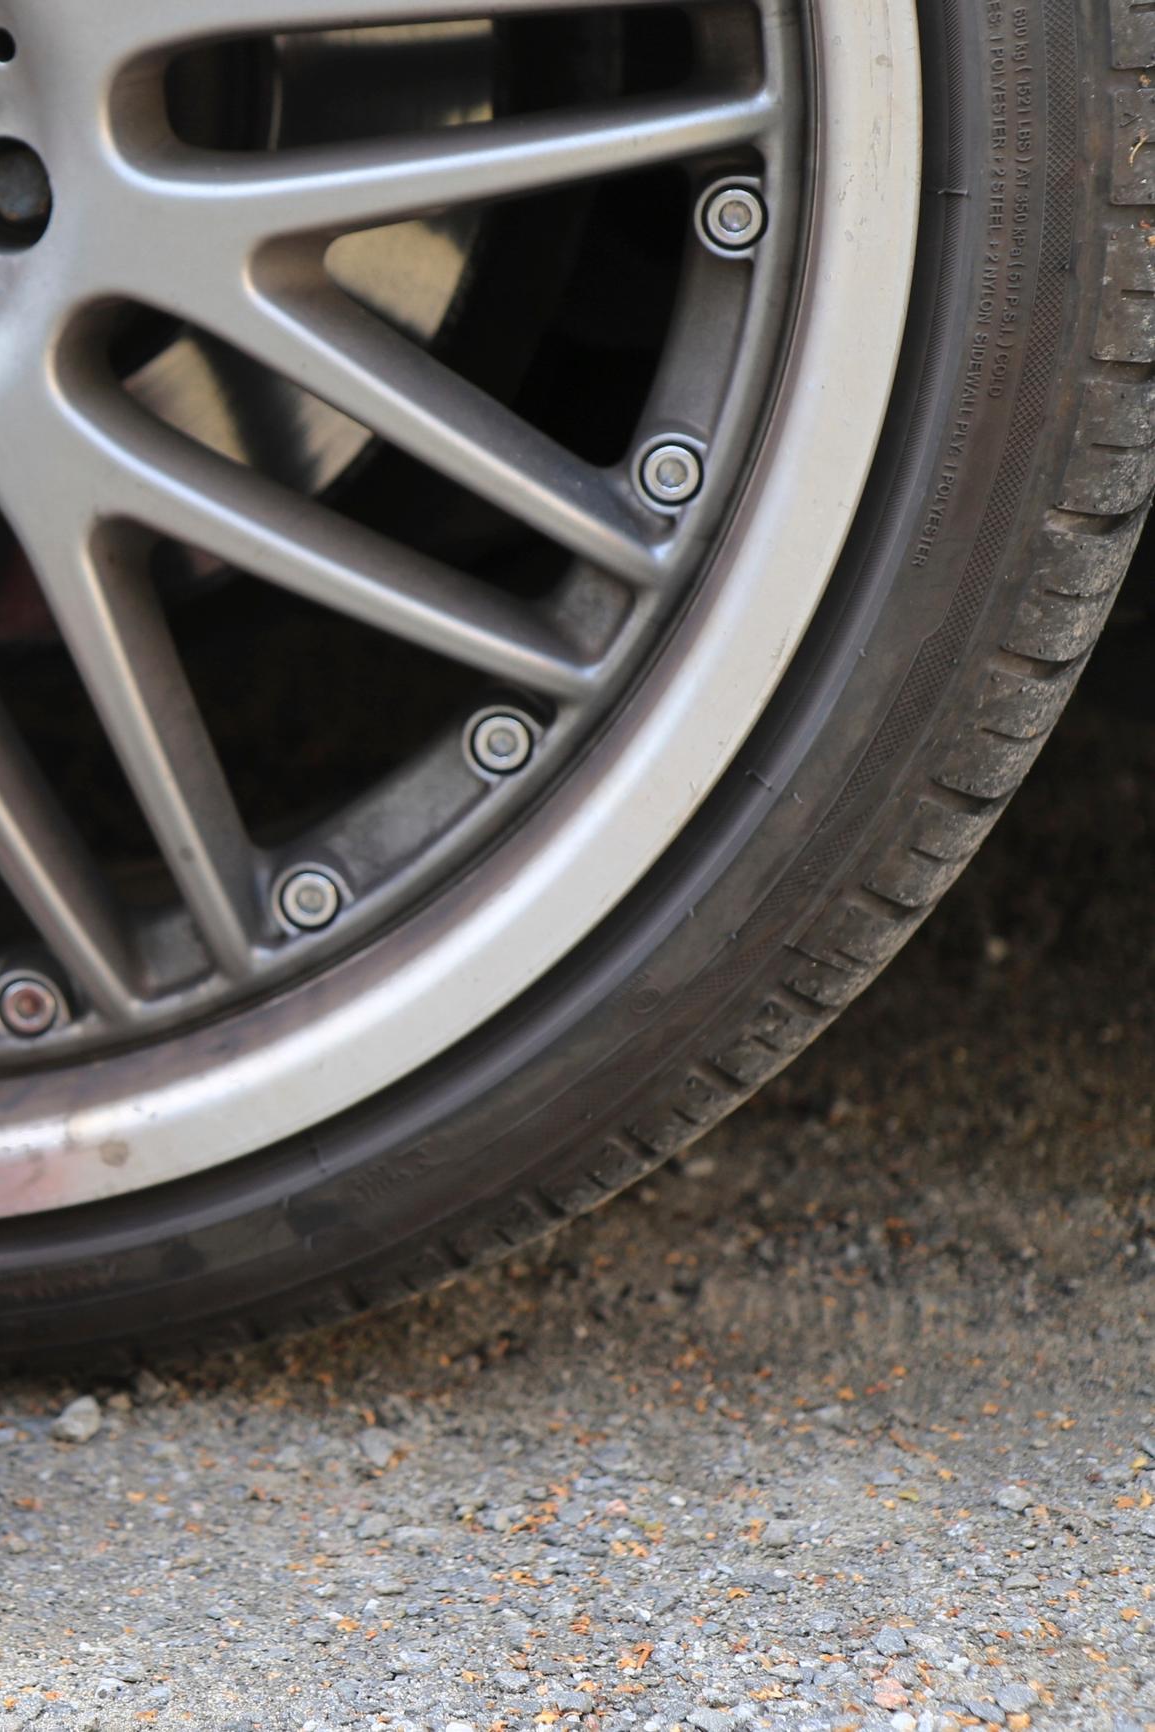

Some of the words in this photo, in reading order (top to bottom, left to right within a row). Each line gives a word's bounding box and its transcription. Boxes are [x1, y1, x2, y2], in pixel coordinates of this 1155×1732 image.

[1013, 7, 1028, 38] 690
[990, 47, 1006, 150] POLYESTER
[1017, 77, 1032, 114] 1521
[1017, 120, 1032, 152] LBS
[990, 167, 1006, 177] 2
[1014, 166, 1031, 189] AT
[988, 181, 1006, 235] STEEL
[1014, 193, 1029, 223] 350
[986, 252, 999, 263] 2
[977, 267, 999, 325] NYLON
[957, 332, 989, 414] SIDEWALL
[989, 352, 1009, 398] COLD
[911, 473, 955, 568] POLYESTER
